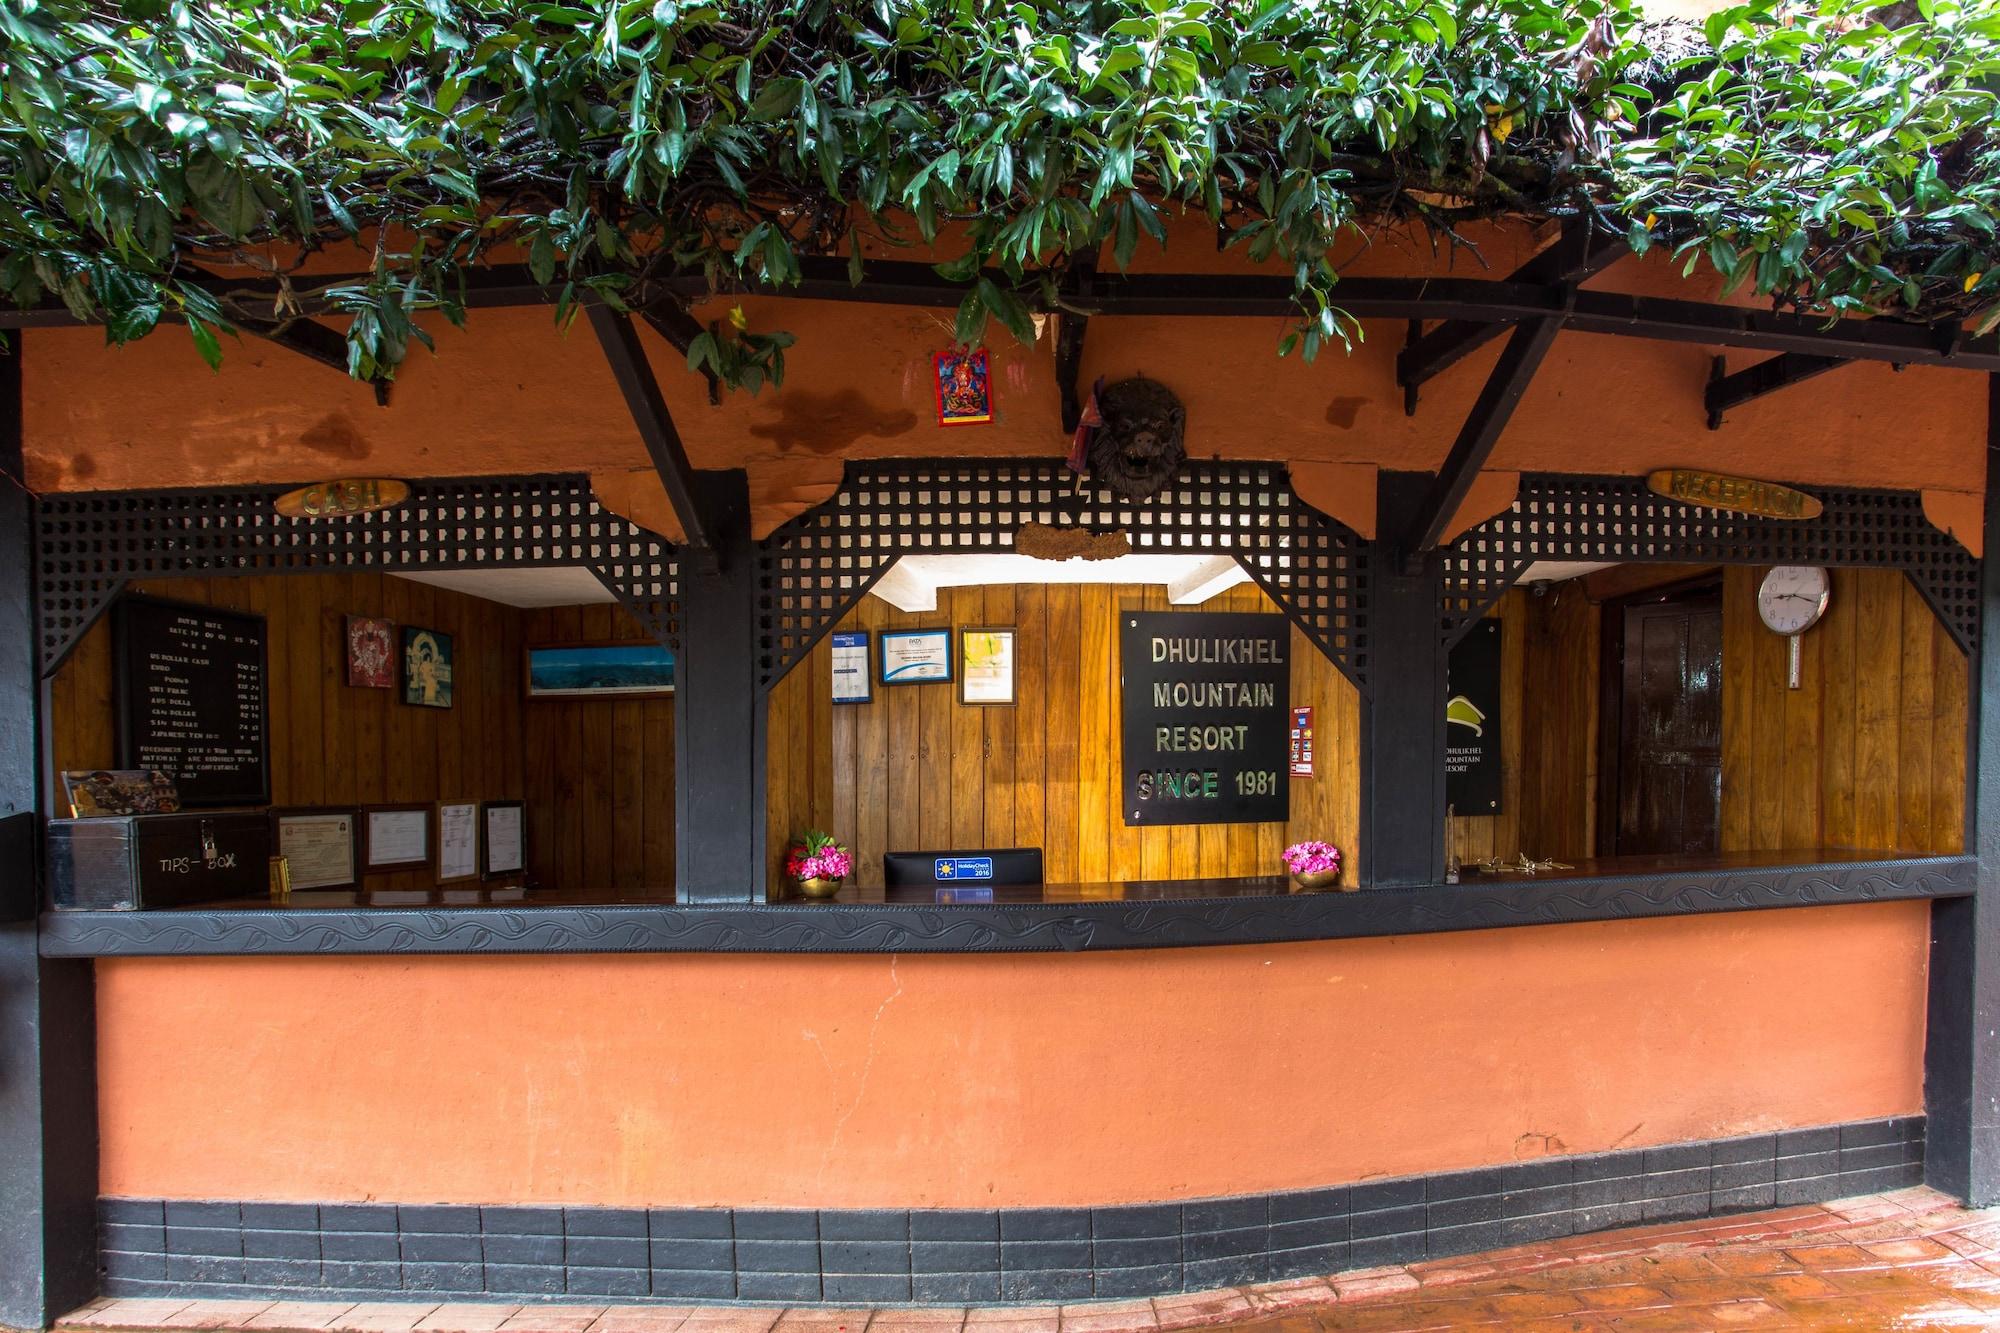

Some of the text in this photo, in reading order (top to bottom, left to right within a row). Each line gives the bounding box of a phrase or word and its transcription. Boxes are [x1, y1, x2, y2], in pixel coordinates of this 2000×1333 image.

[302, 480, 381, 515] CASH
[1672, 470, 1803, 517] RECEPTION
[1769, 582, 1778, 592] 10
[1770, 610, 1776, 620] 8
[1780, 618, 1784, 628] 7
[1792, 618, 1798, 628] 6
[1151, 637, 1283, 664] DHULIKHEL
[161, 654, 189, 664] DOLLAR
[1153, 682, 1274, 708] MOUNTAIN
[172, 720, 198, 728] DOLLAR
[150, 730, 186, 738] JAPANESE
[1156, 725, 1248, 752] RESORT
[1136, 769, 1277, 800] SINCE 1981
[208, 852, 237, 870] BOX
